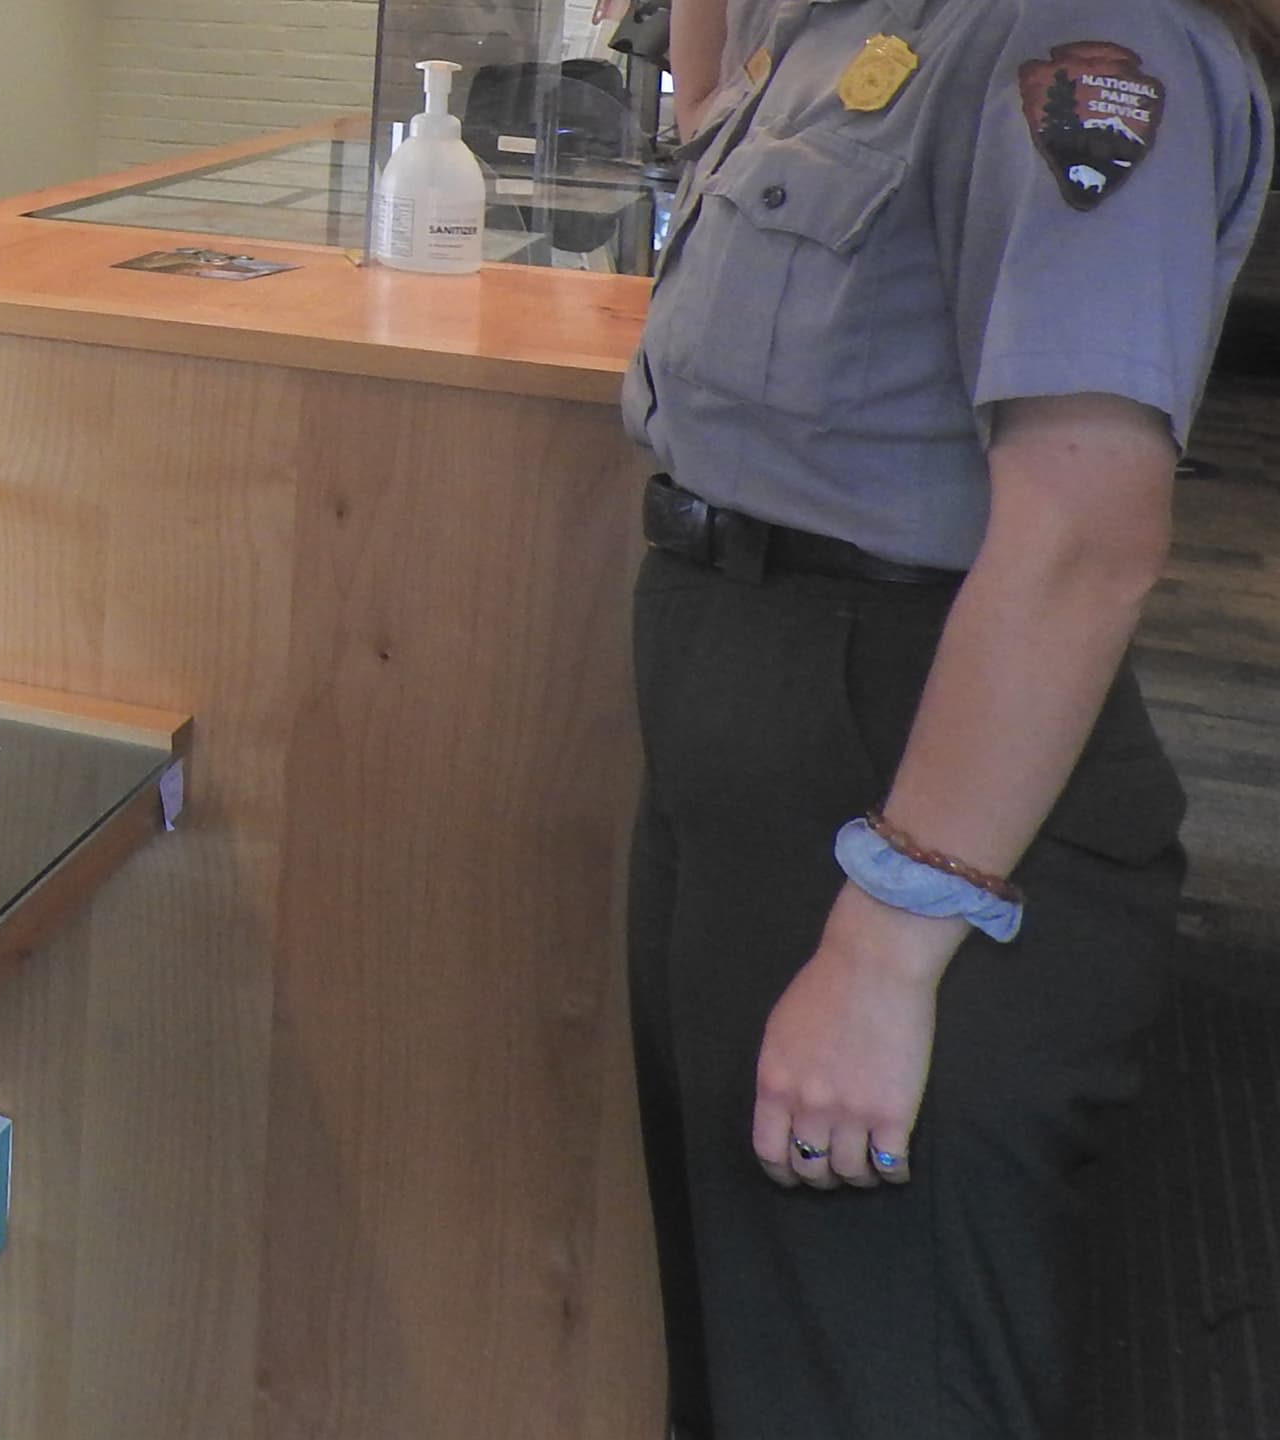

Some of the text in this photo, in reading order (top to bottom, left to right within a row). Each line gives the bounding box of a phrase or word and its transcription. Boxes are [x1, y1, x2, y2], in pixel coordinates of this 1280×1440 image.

[1082, 74, 1159, 99] NATIONAL
[1101, 89, 1140, 107] PARK
[1088, 100, 1151, 122] SERVICE
